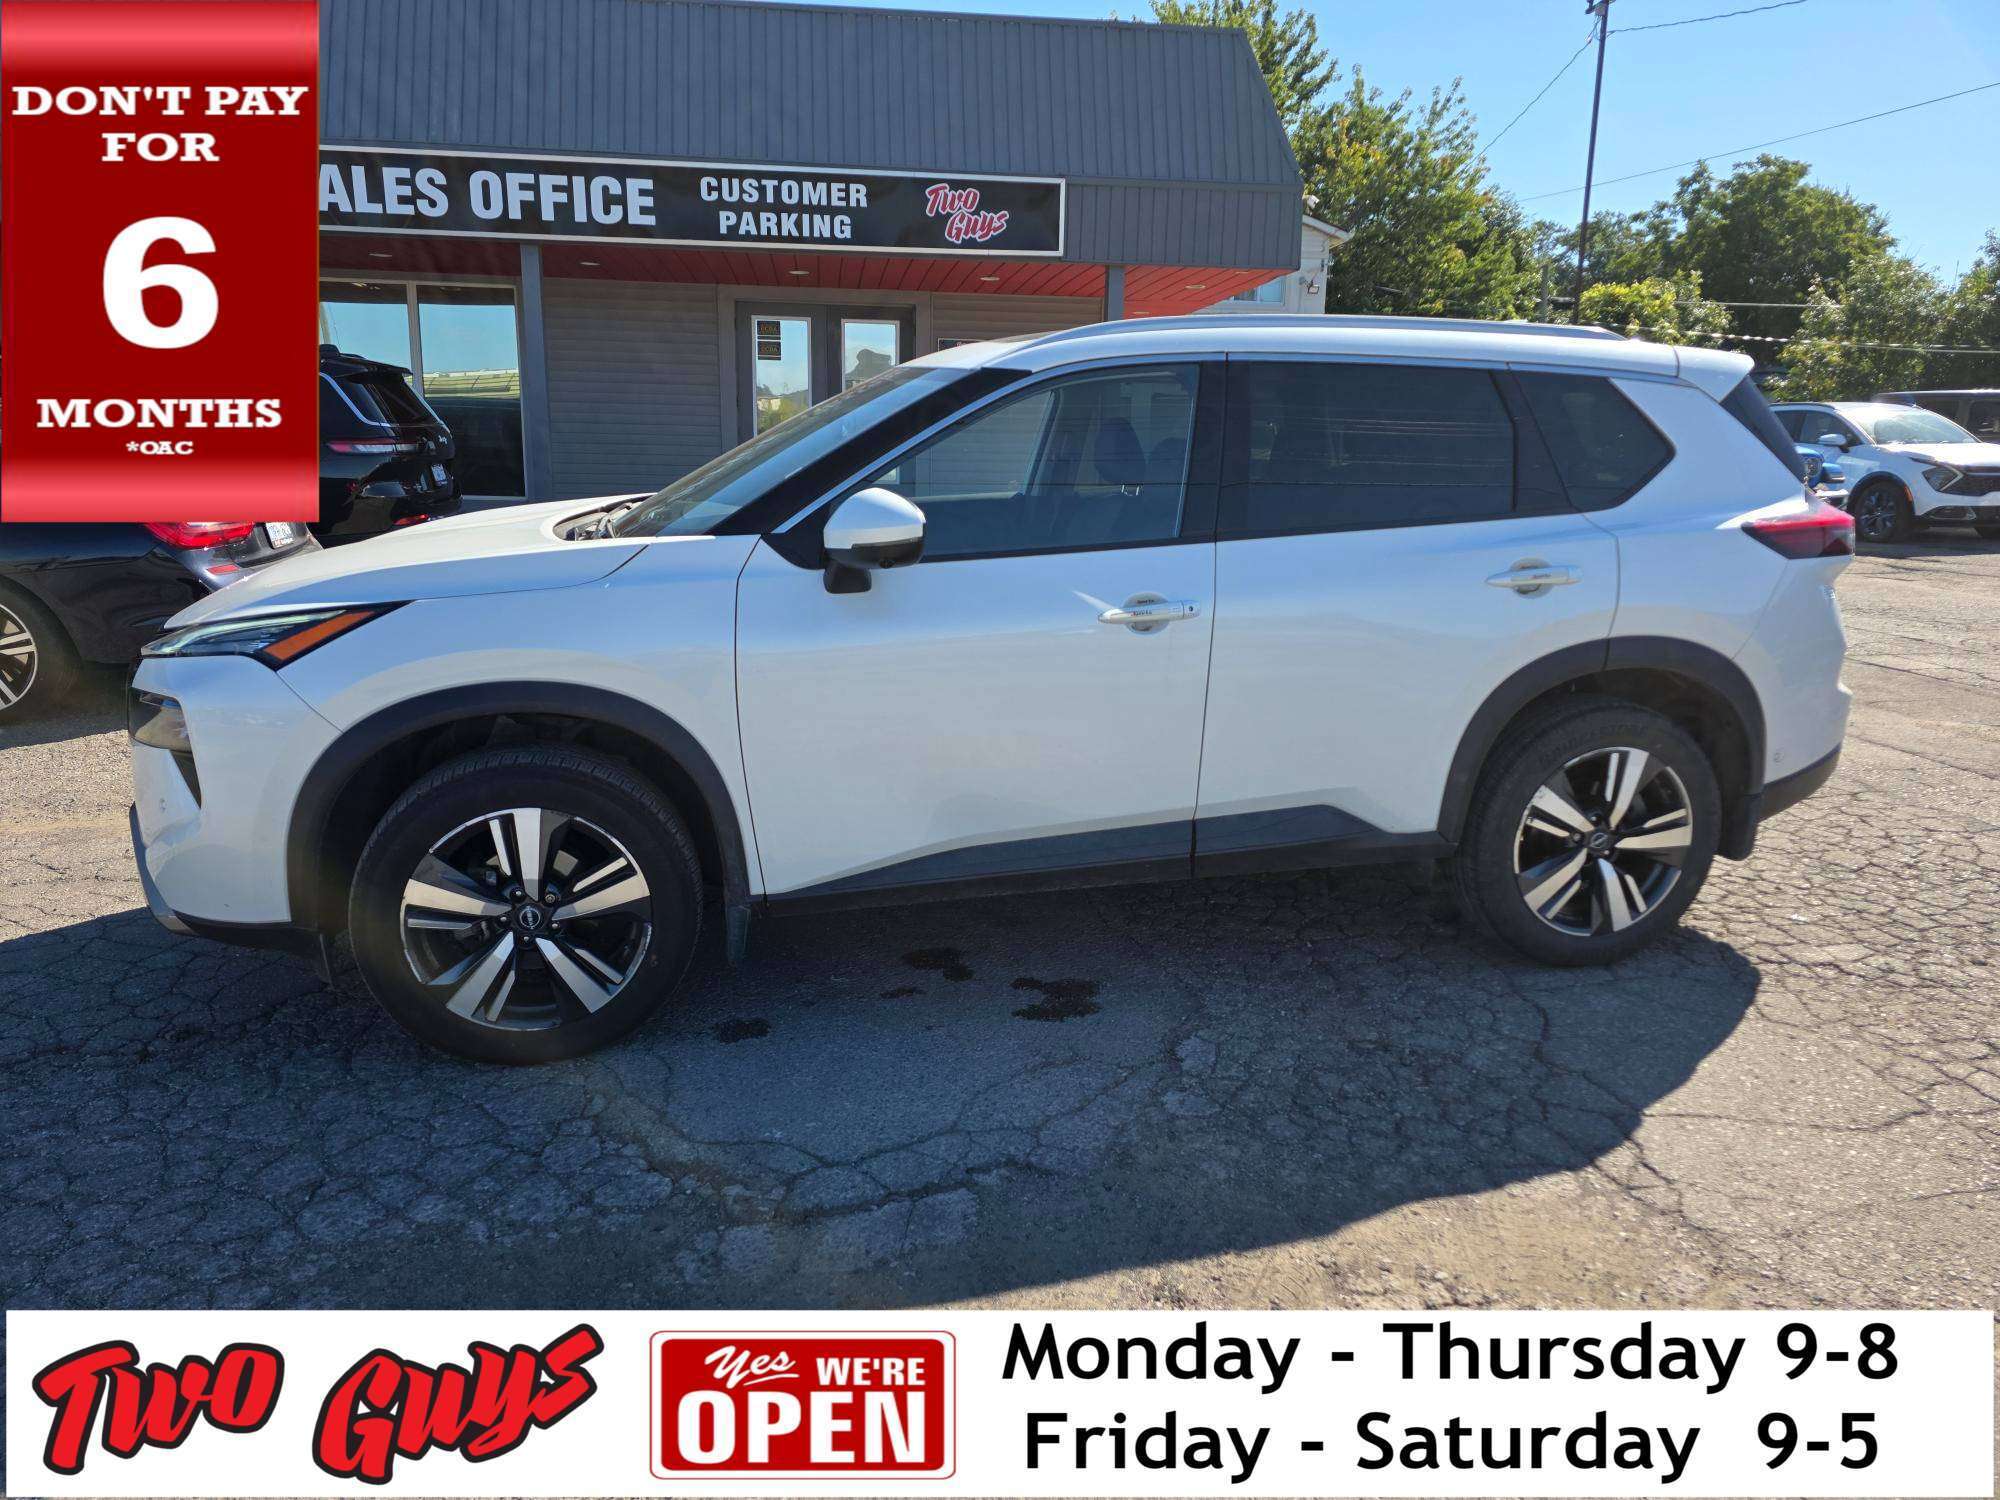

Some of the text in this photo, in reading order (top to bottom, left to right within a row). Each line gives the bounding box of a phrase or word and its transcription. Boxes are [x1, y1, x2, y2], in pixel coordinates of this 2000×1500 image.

[469, 170, 656, 226] OFFICE
[700, 176, 868, 208] CUSTOMER
[926, 183, 980, 217] Two
[719, 210, 852, 239] PARKING
[945, 210, 1009, 244] Guys
